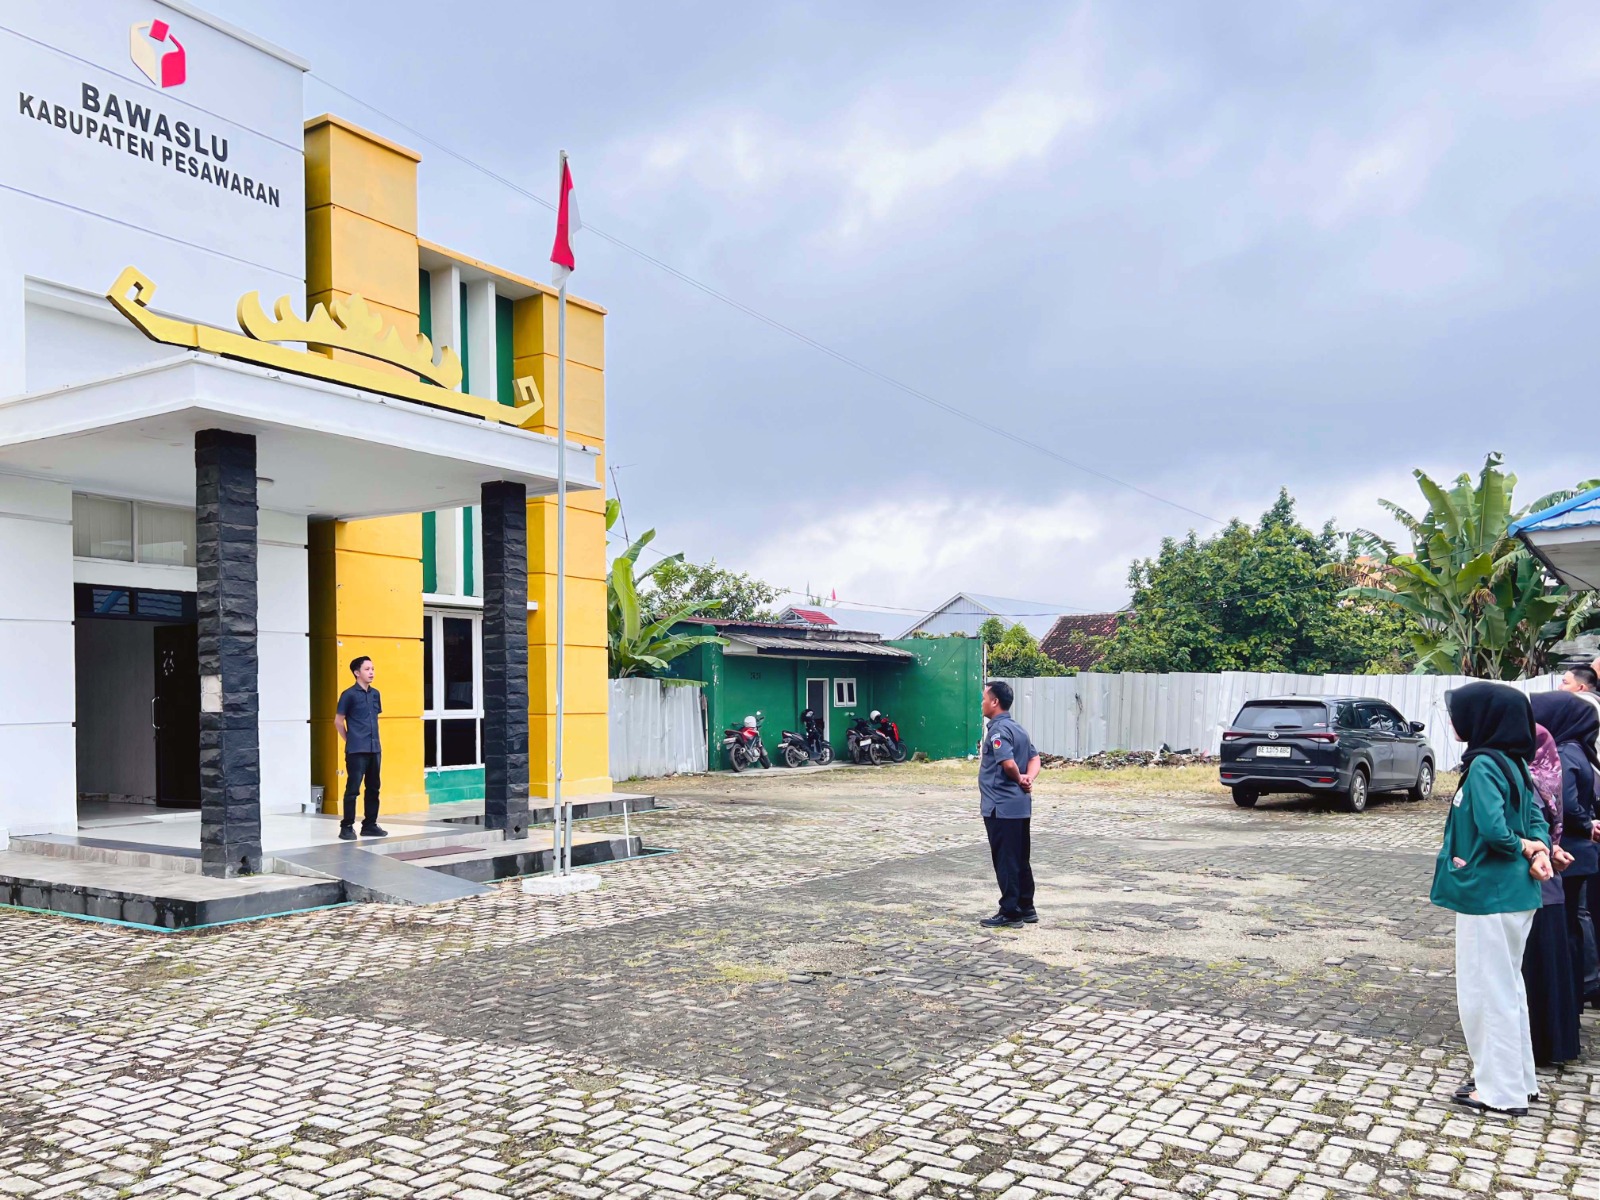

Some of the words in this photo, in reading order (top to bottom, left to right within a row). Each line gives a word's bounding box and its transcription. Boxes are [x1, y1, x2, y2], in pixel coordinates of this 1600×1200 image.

[19, 91, 154, 162] KABUPATEN
[161, 145, 280, 208] PESAWARAN
[82, 82, 228, 163] BAWASLU
